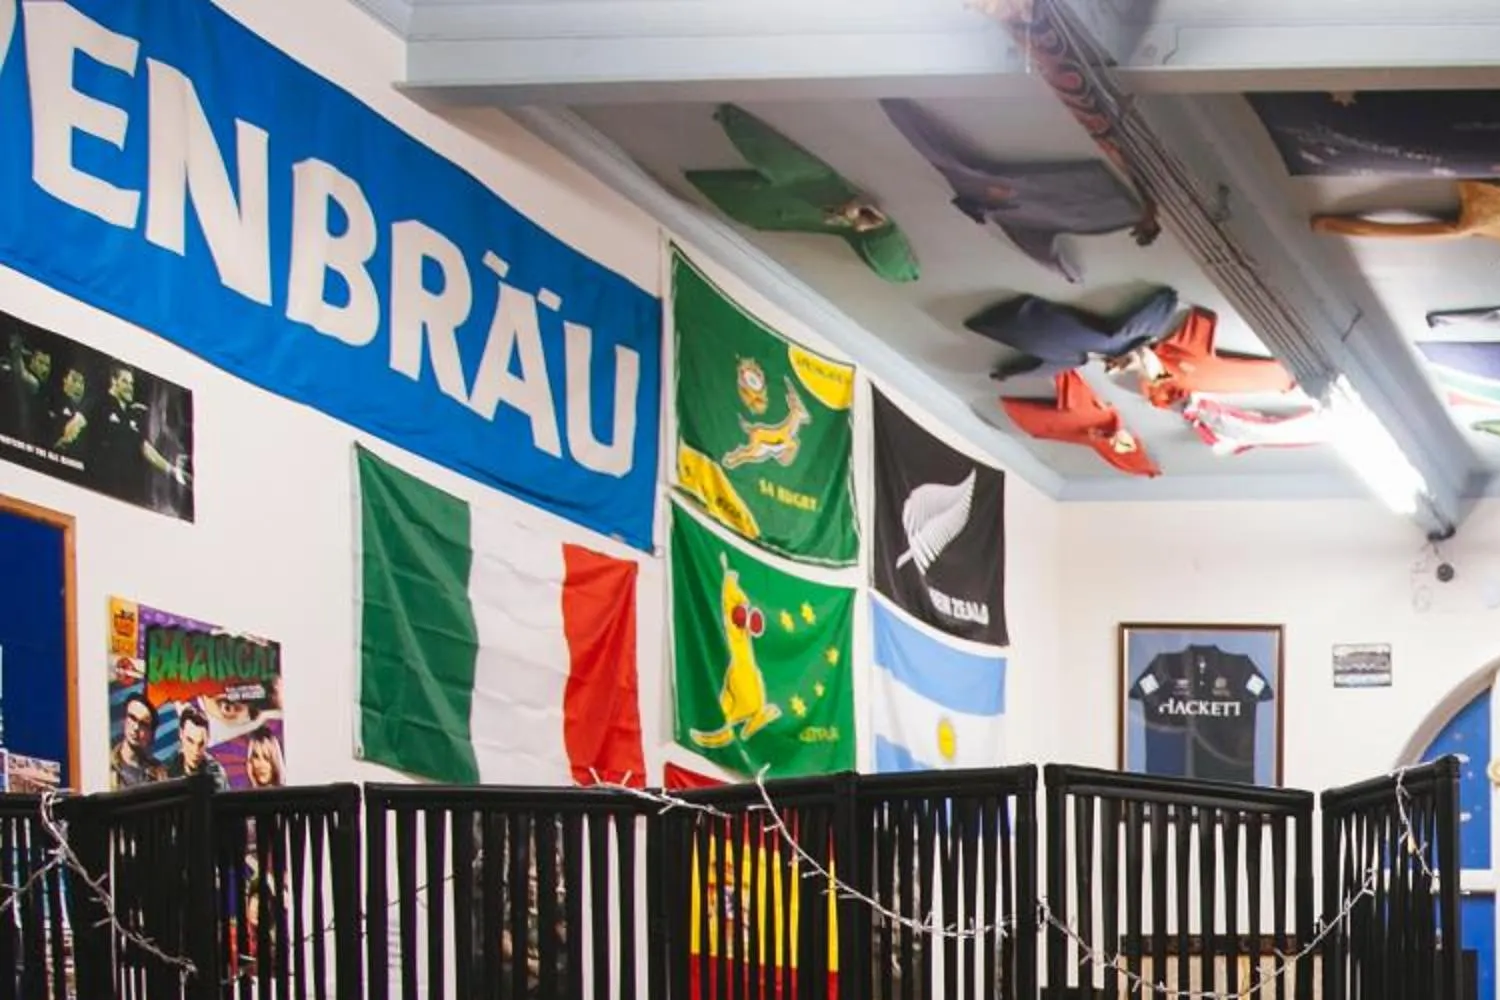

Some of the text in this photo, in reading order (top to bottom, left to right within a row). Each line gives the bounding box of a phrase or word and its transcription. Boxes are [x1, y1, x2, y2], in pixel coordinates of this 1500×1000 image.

[0, 0, 641, 478] ENBRÄU
[759, 478, 817, 512] SA RUGBY
[147, 626, 278, 685] BAZINGA!
[1159, 697, 1241, 717] HACKETT
